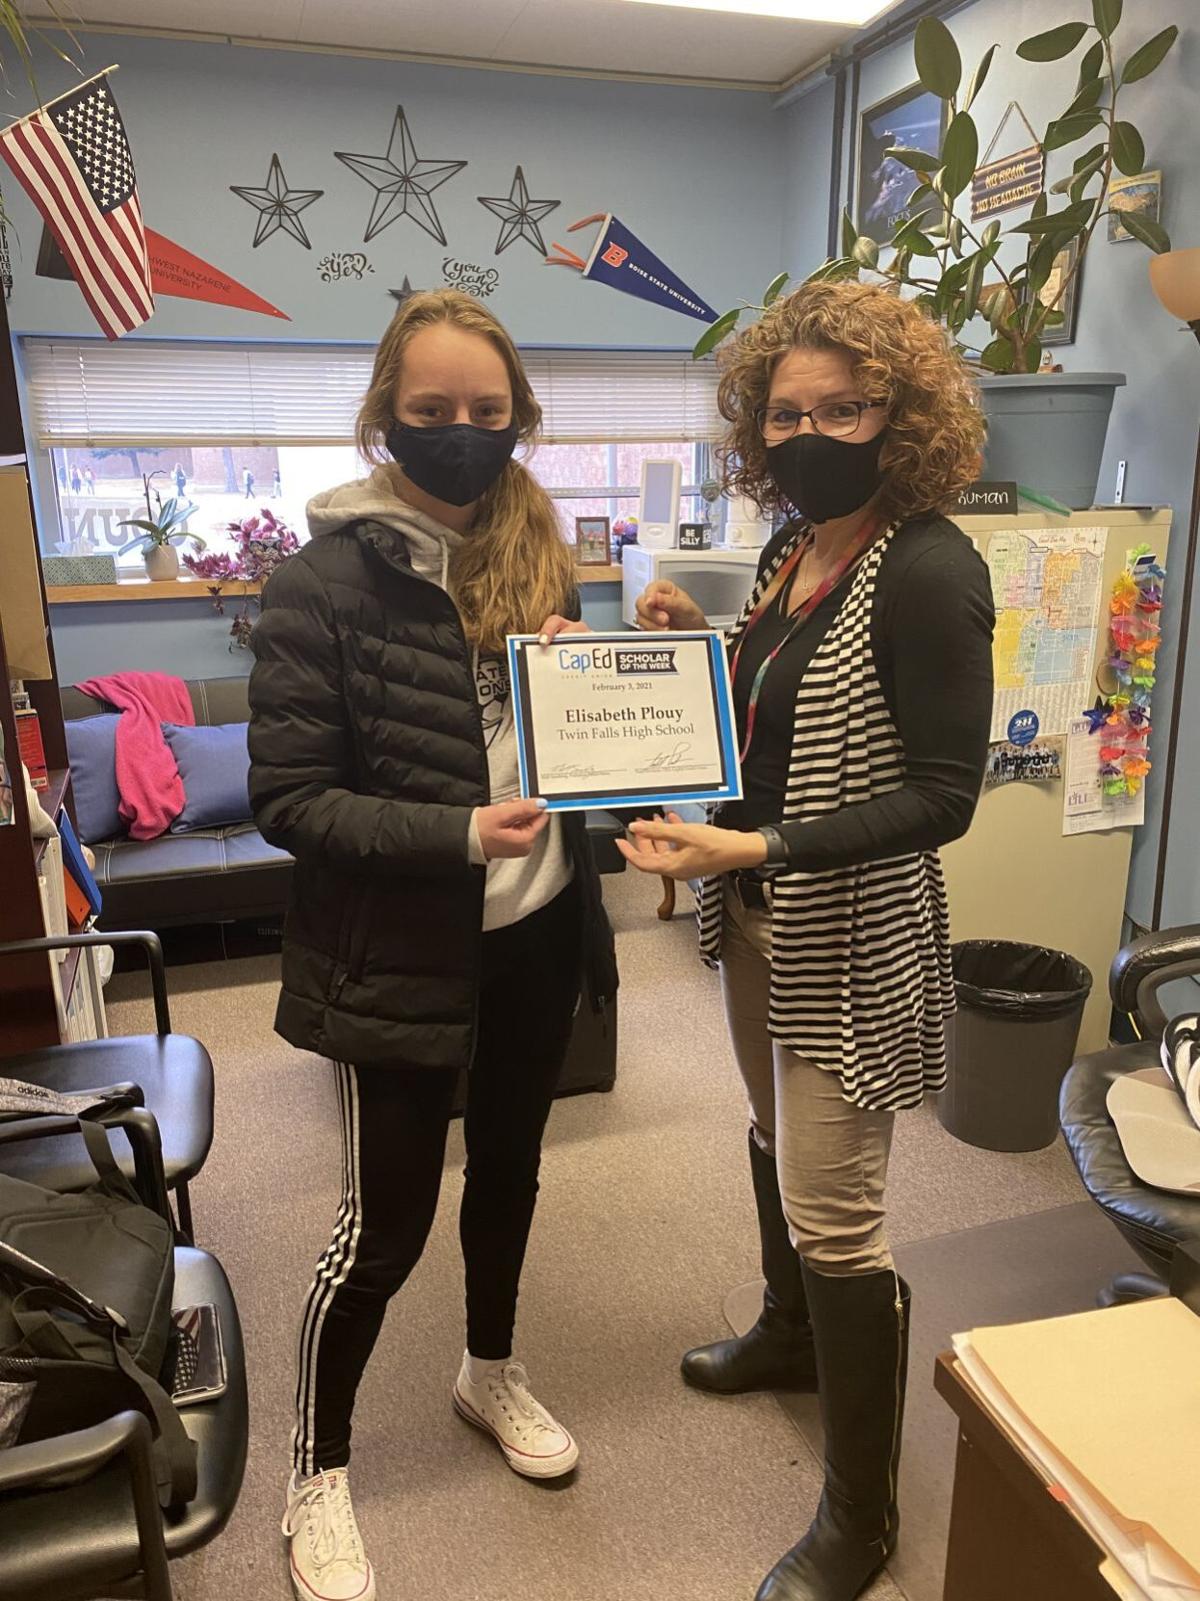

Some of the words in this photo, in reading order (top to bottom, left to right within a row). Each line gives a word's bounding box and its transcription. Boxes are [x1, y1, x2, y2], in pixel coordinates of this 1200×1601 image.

[985, 173, 999, 189] NO
[999, 162, 1026, 184] BRAIN
[975, 198, 988, 214] NO
[601, 241, 629, 267] B
[628, 263, 648, 278] BOISE
[648, 275, 668, 291] STATE
[668, 289, 706, 315] UNIVERSITY
[681, 537, 700, 545] SILLY
[685, 529, 695, 537] BE
[558, 648, 612, 674] CapEd
[619, 653, 671, 664] SCHOLAR
[649, 661, 672, 670] WEEK
[592, 683, 626, 692] February
[636, 681, 653, 690] 2021
[566, 706, 636, 723] Elisabeth
[641, 706, 683, 722] Plouy
[557, 729, 589, 740] Twin
[592, 727, 620, 739] Falls
[623, 725, 653, 740] High
[655, 723, 695, 736] School
